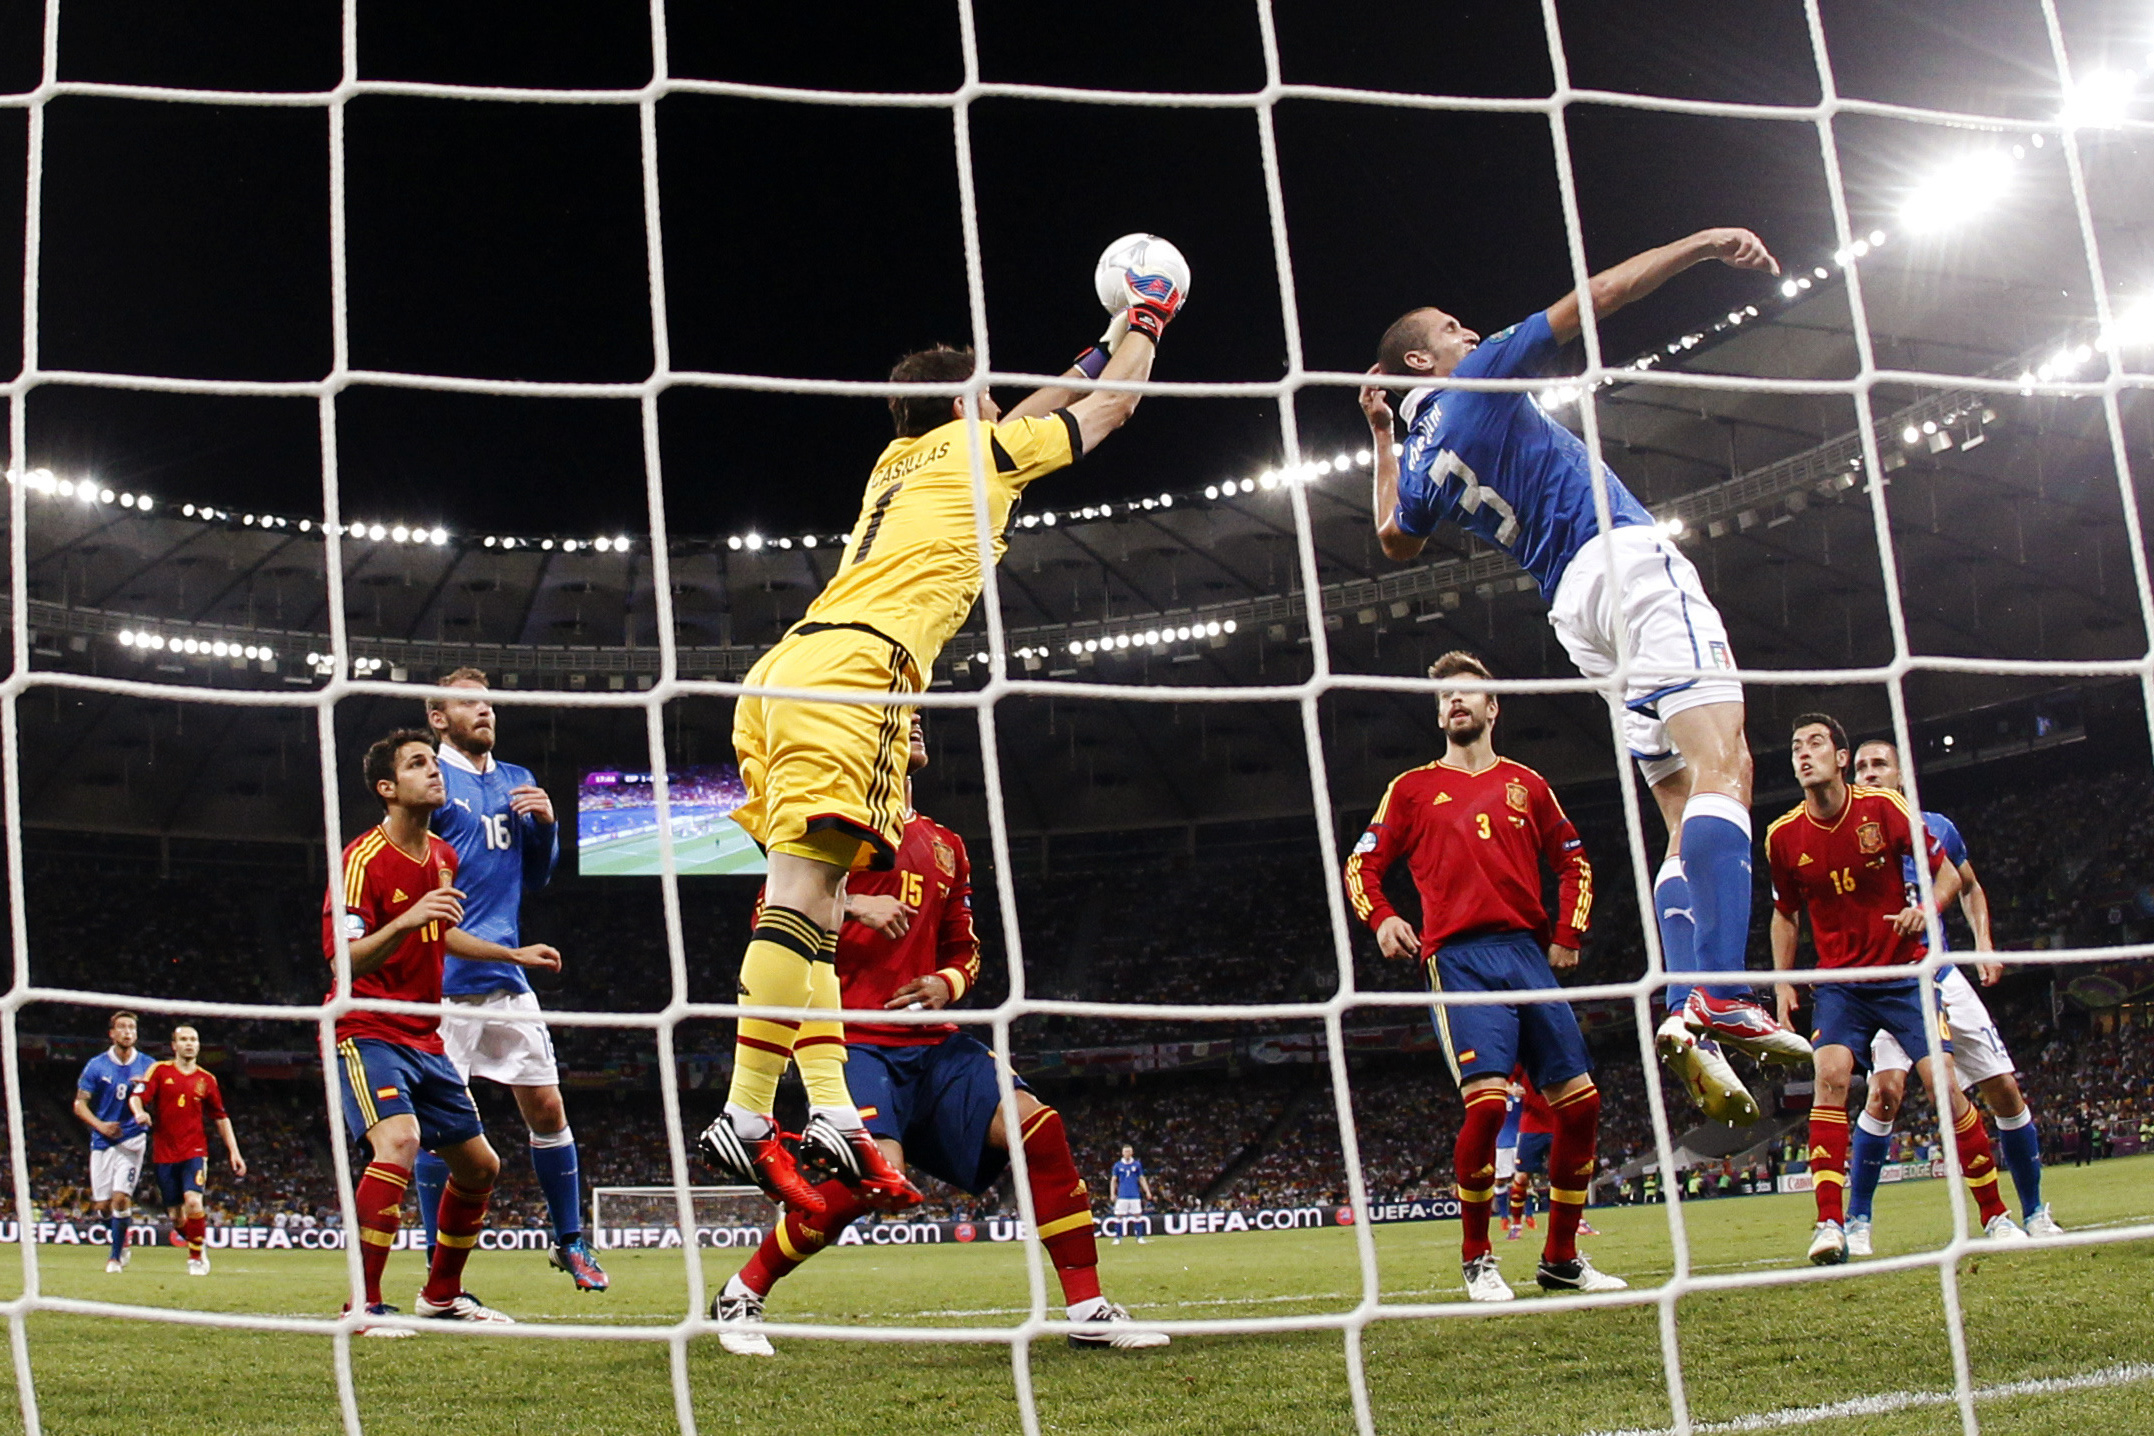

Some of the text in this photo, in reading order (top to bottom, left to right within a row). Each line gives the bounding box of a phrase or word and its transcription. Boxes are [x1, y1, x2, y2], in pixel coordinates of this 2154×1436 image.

[871, 441, 950, 489] CASILLAS
[1429, 448, 1521, 549] 3
[852, 482, 903, 565] 1
[481, 813, 512, 851] 16
[1475, 813, 1492, 840] 3
[899, 869, 925, 907] 15
[1829, 867, 1857, 895] 16
[1938, 1010, 1953, 1041] 6
[116, 1083, 128, 1101] 8
[177, 1093, 186, 1108] 6
[127, 1167, 136, 1183] 8
[195, 1169, 206, 1186] 6
[1902, 1163, 1931, 1180] EDGE
